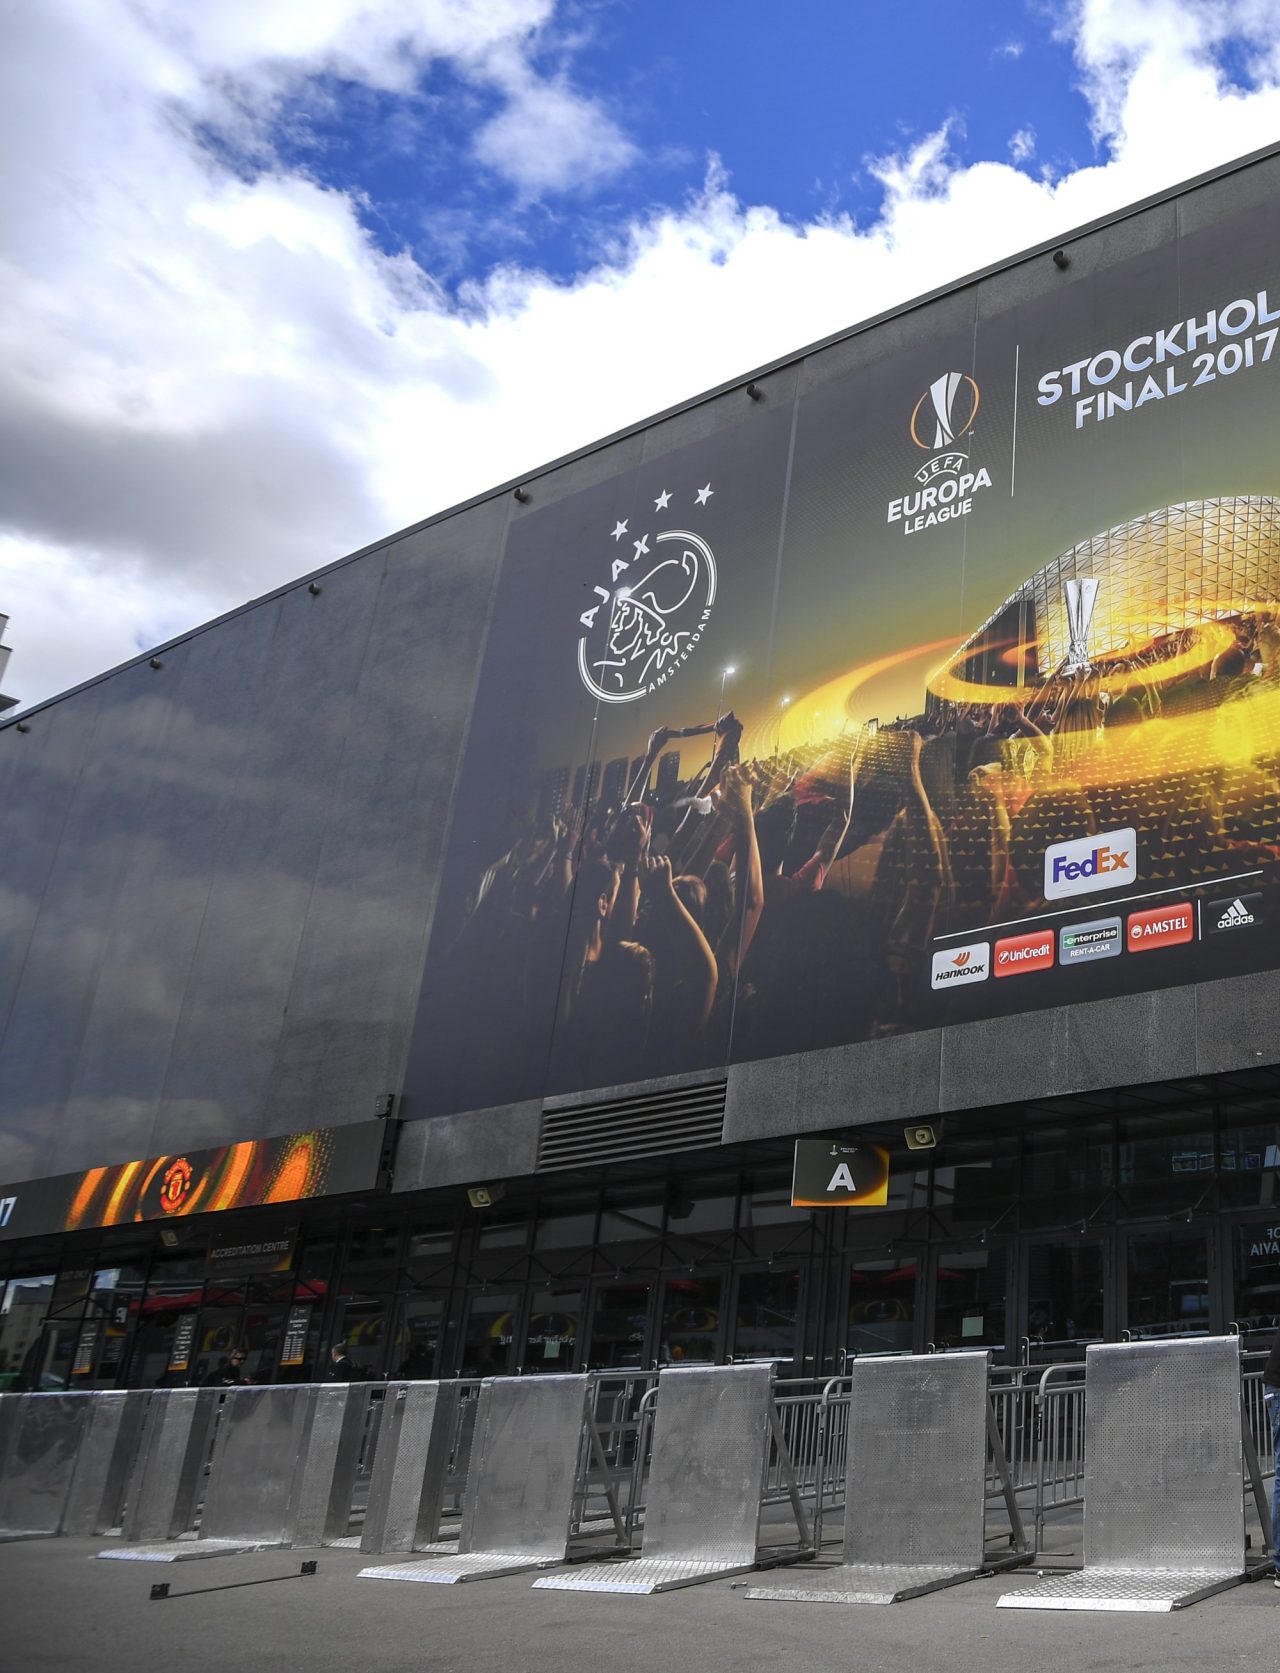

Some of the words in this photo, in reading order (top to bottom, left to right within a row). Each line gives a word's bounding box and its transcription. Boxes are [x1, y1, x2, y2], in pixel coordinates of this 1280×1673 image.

[1075, 374, 1188, 430] FINAL
[1192, 327, 1280, 387] 2017
[917, 456, 963, 482] UEFA
[887, 467, 992, 523] EUROPA
[904, 498, 973, 535] LEAGUE
[579, 533, 651, 629] AJAX
[649, 608, 712, 693] AMSTERDAM
[1053, 846, 1130, 883] FedEx
[1143, 917, 1188, 936] AMSTEL
[1217, 913, 1255, 929] adidas
[1065, 929, 1117, 945] enterprise
[1070, 944, 1111, 958] RENT-A-CAR
[1010, 943, 1051, 962] UniCredit
[826, 1162, 857, 1192] A
[211, 1243, 262, 1258] ACCREDITATION
[262, 1240, 290, 1253] CENTRE
